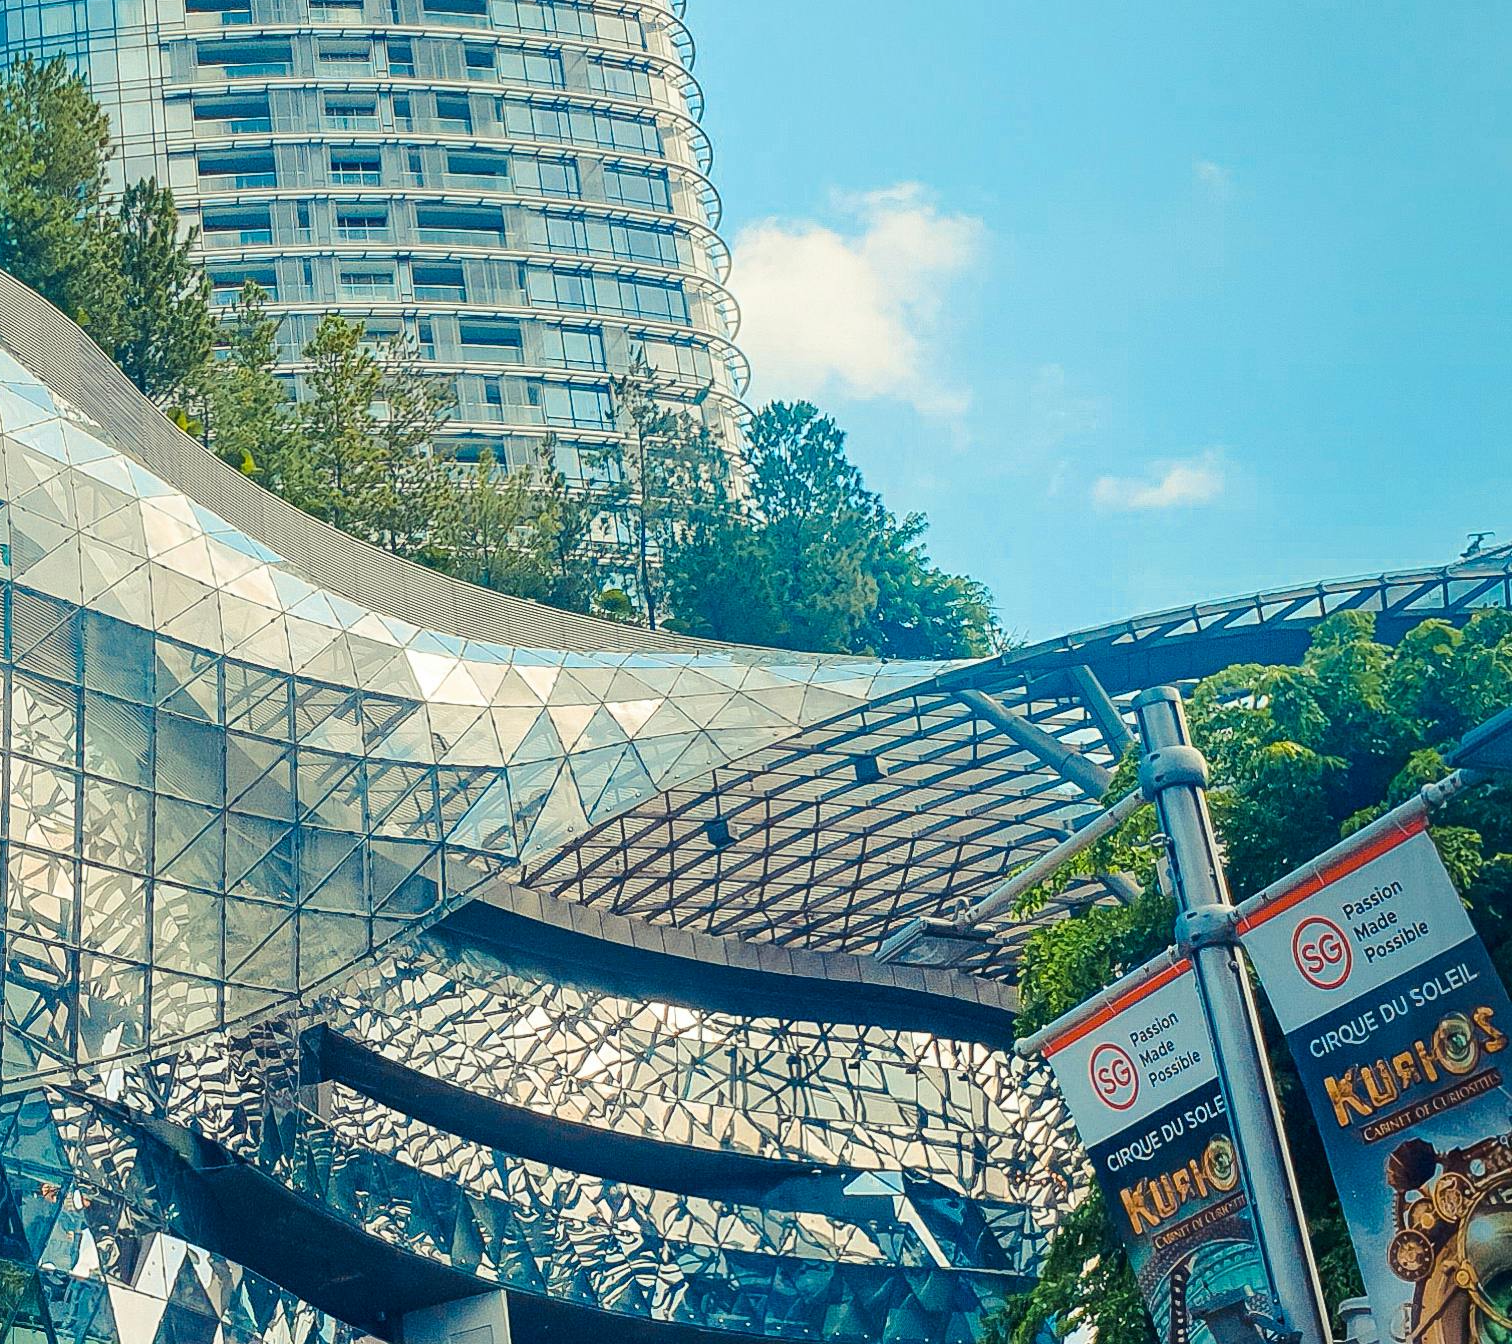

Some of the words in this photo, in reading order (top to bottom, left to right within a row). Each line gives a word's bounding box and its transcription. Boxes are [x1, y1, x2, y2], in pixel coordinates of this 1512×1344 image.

[1342, 881, 1403, 920] Passion
[1353, 911, 1398, 942] Made
[1363, 922, 1429, 963] Possible
[1302, 934, 1343, 973] SG
[1130, 1012, 1179, 1047] Passion
[1309, 1011, 1379, 1057] CIRQUE
[1379, 996, 1409, 1023] DU
[1409, 963, 1478, 1006] SOLEIL
[1139, 1040, 1175, 1067] Made
[1148, 1051, 1201, 1087] Possible
[1098, 1059, 1131, 1094] SG
[1107, 1130, 1162, 1172] CIRQUE
[1161, 1118, 1185, 1143] DU
[1184, 1095, 1226, 1129] SOLE
[1119, 1132, 1238, 1234] KURIO
